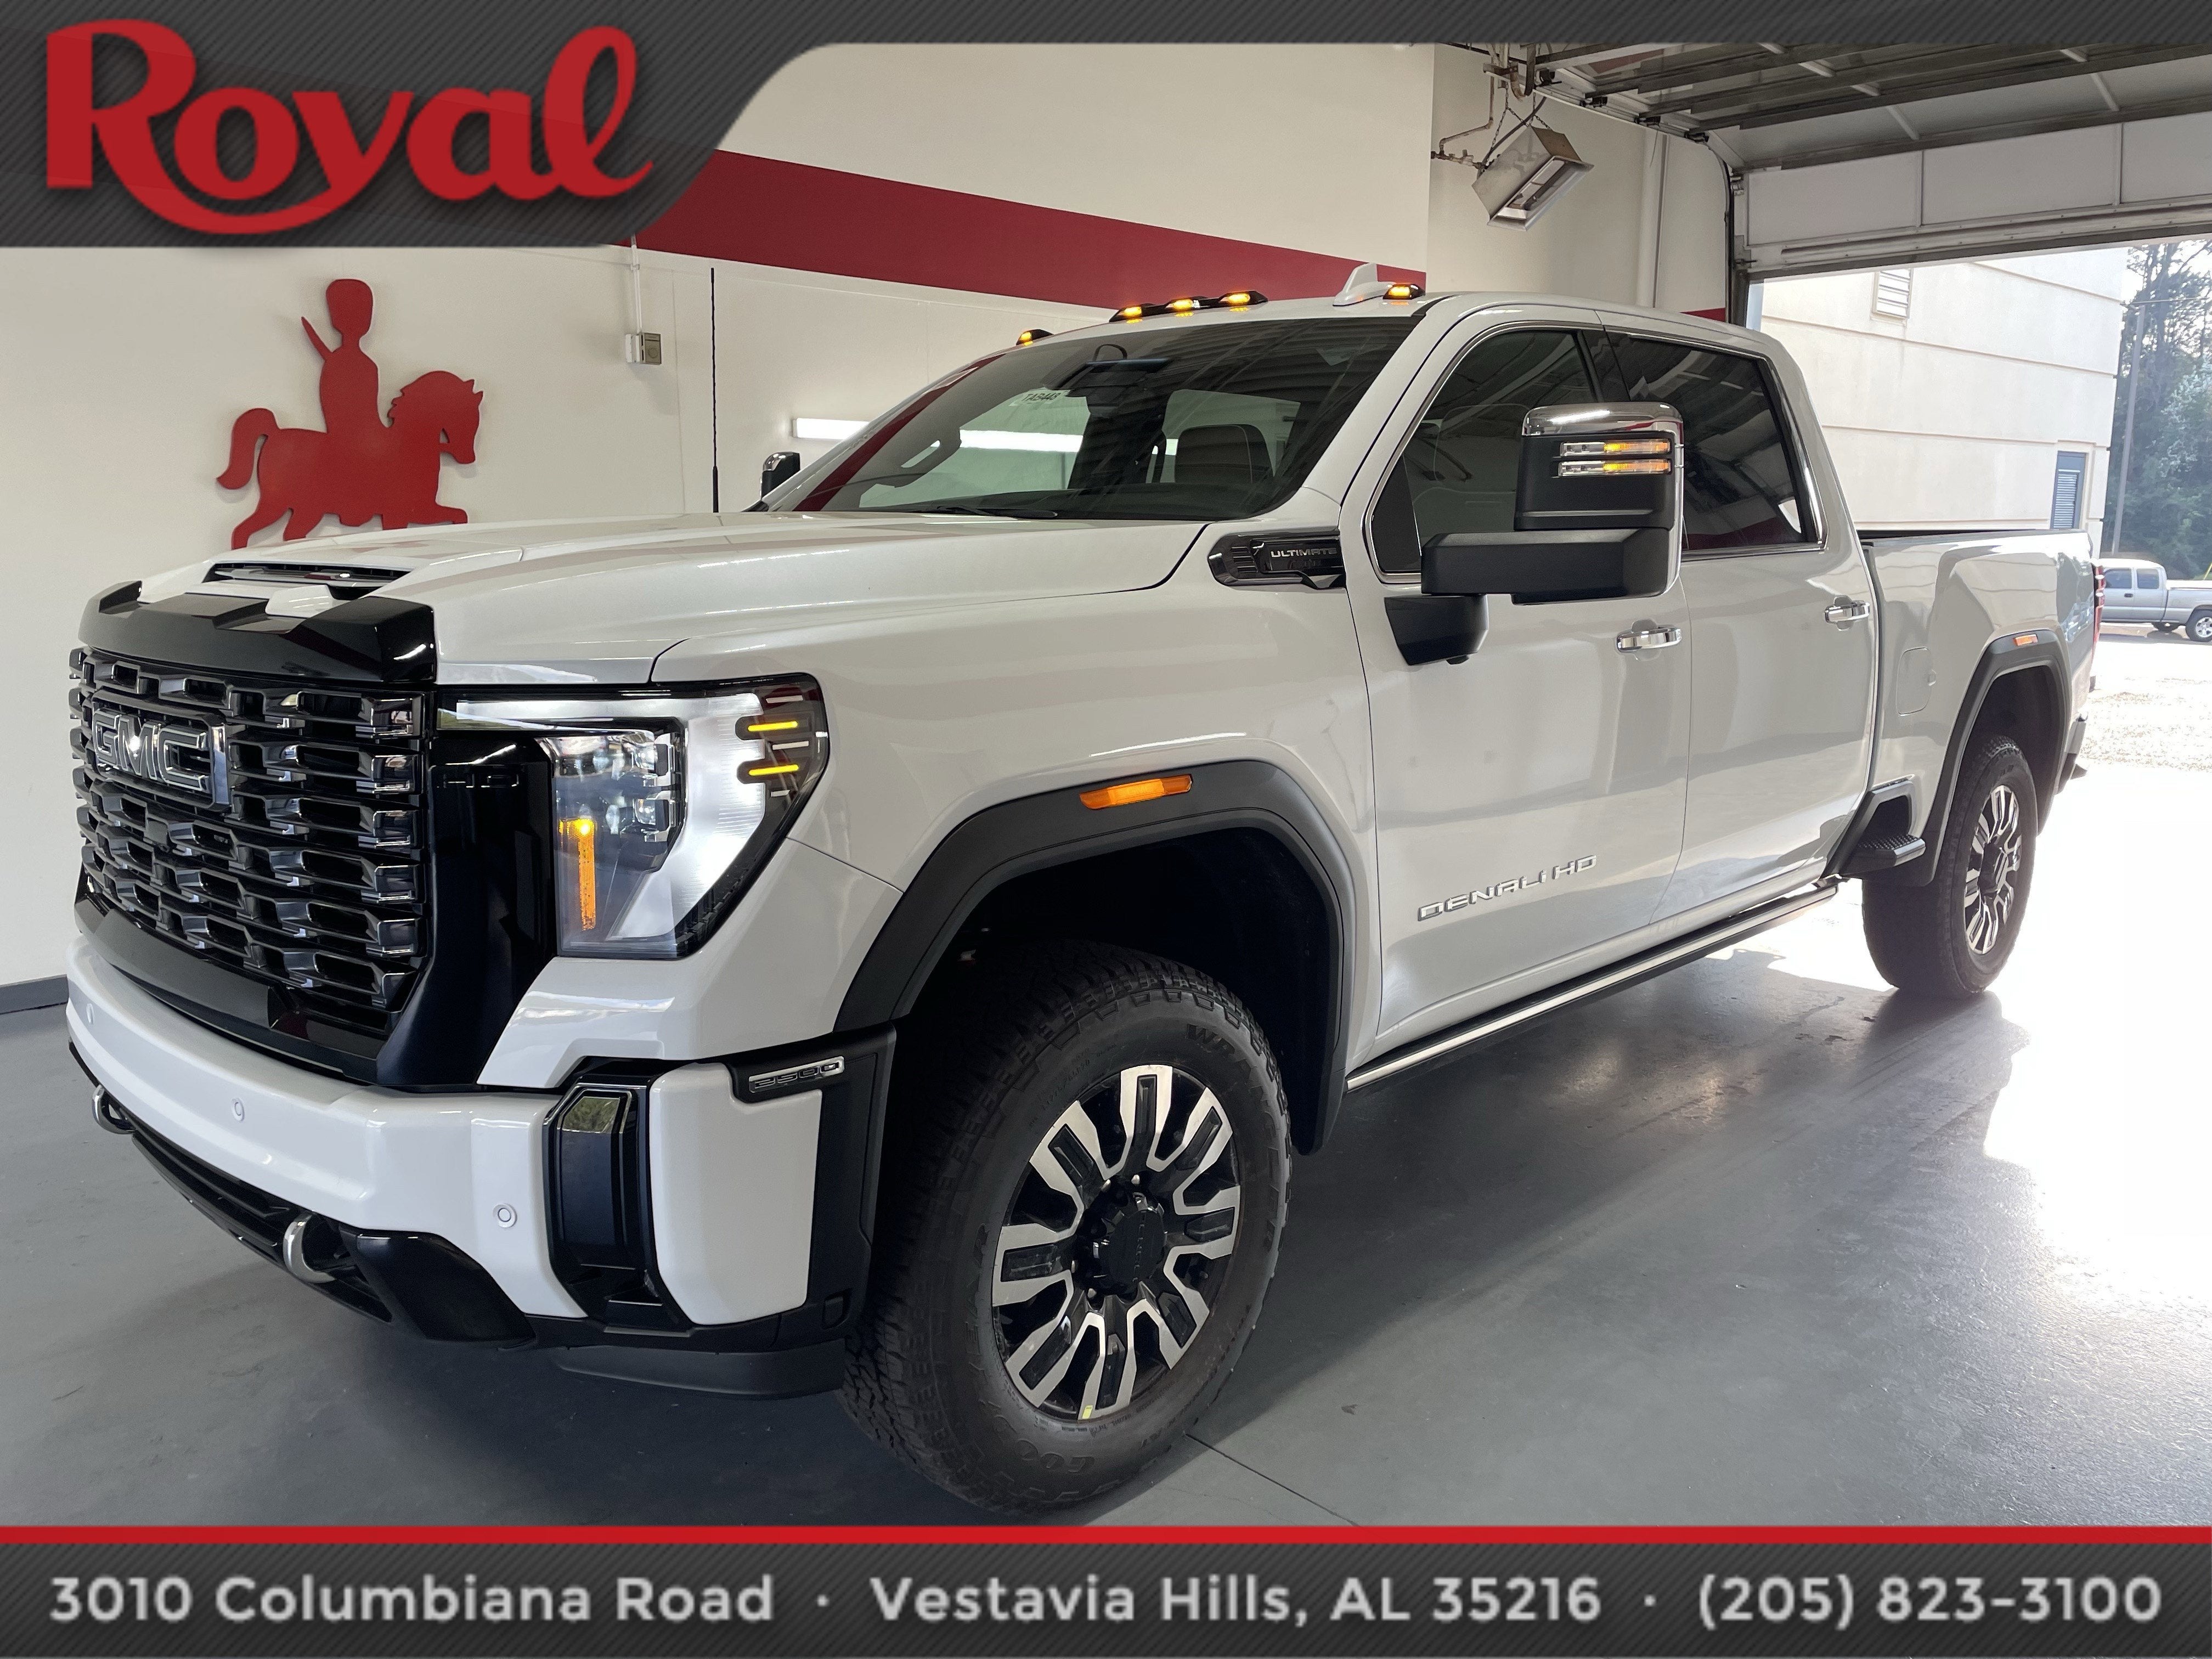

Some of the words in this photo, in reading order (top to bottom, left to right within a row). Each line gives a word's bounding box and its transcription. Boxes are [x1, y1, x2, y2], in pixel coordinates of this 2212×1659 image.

[1270, 548, 1338, 558] ULTIMATE
[92, 707, 207, 792] GMC
[1417, 869, 1547, 922] DENALI
[1551, 854, 1597, 880] HD
[748, 1056, 845, 1094] 2500
